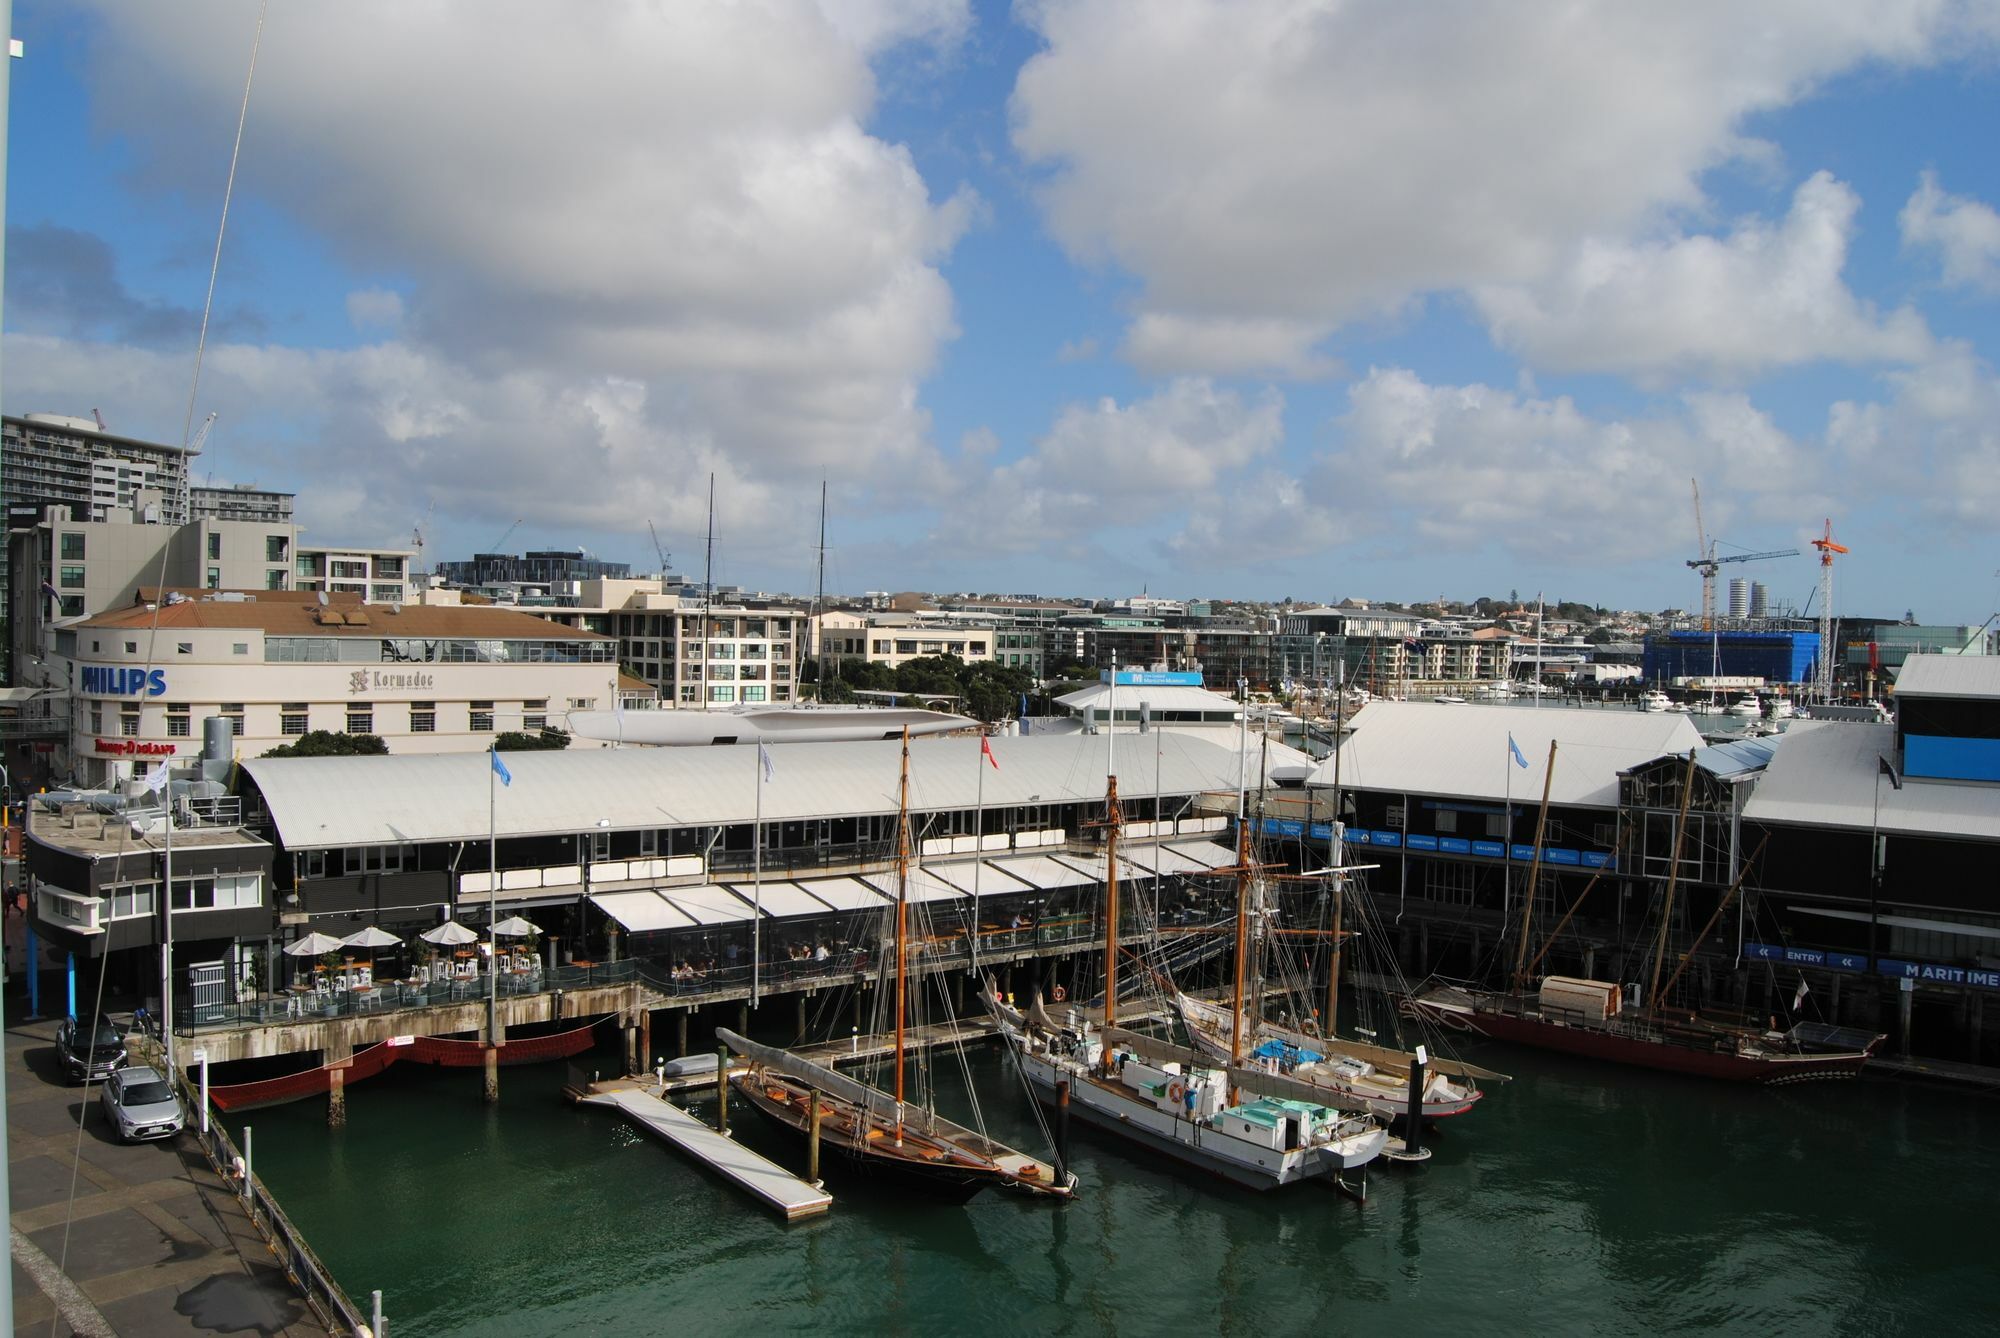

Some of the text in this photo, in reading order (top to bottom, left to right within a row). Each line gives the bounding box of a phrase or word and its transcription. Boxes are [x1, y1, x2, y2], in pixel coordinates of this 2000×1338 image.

[81, 666, 166, 696] PHILIPS
[1787, 951, 1822, 963] ENTRY
[1905, 964, 1999, 987] MARITIME
